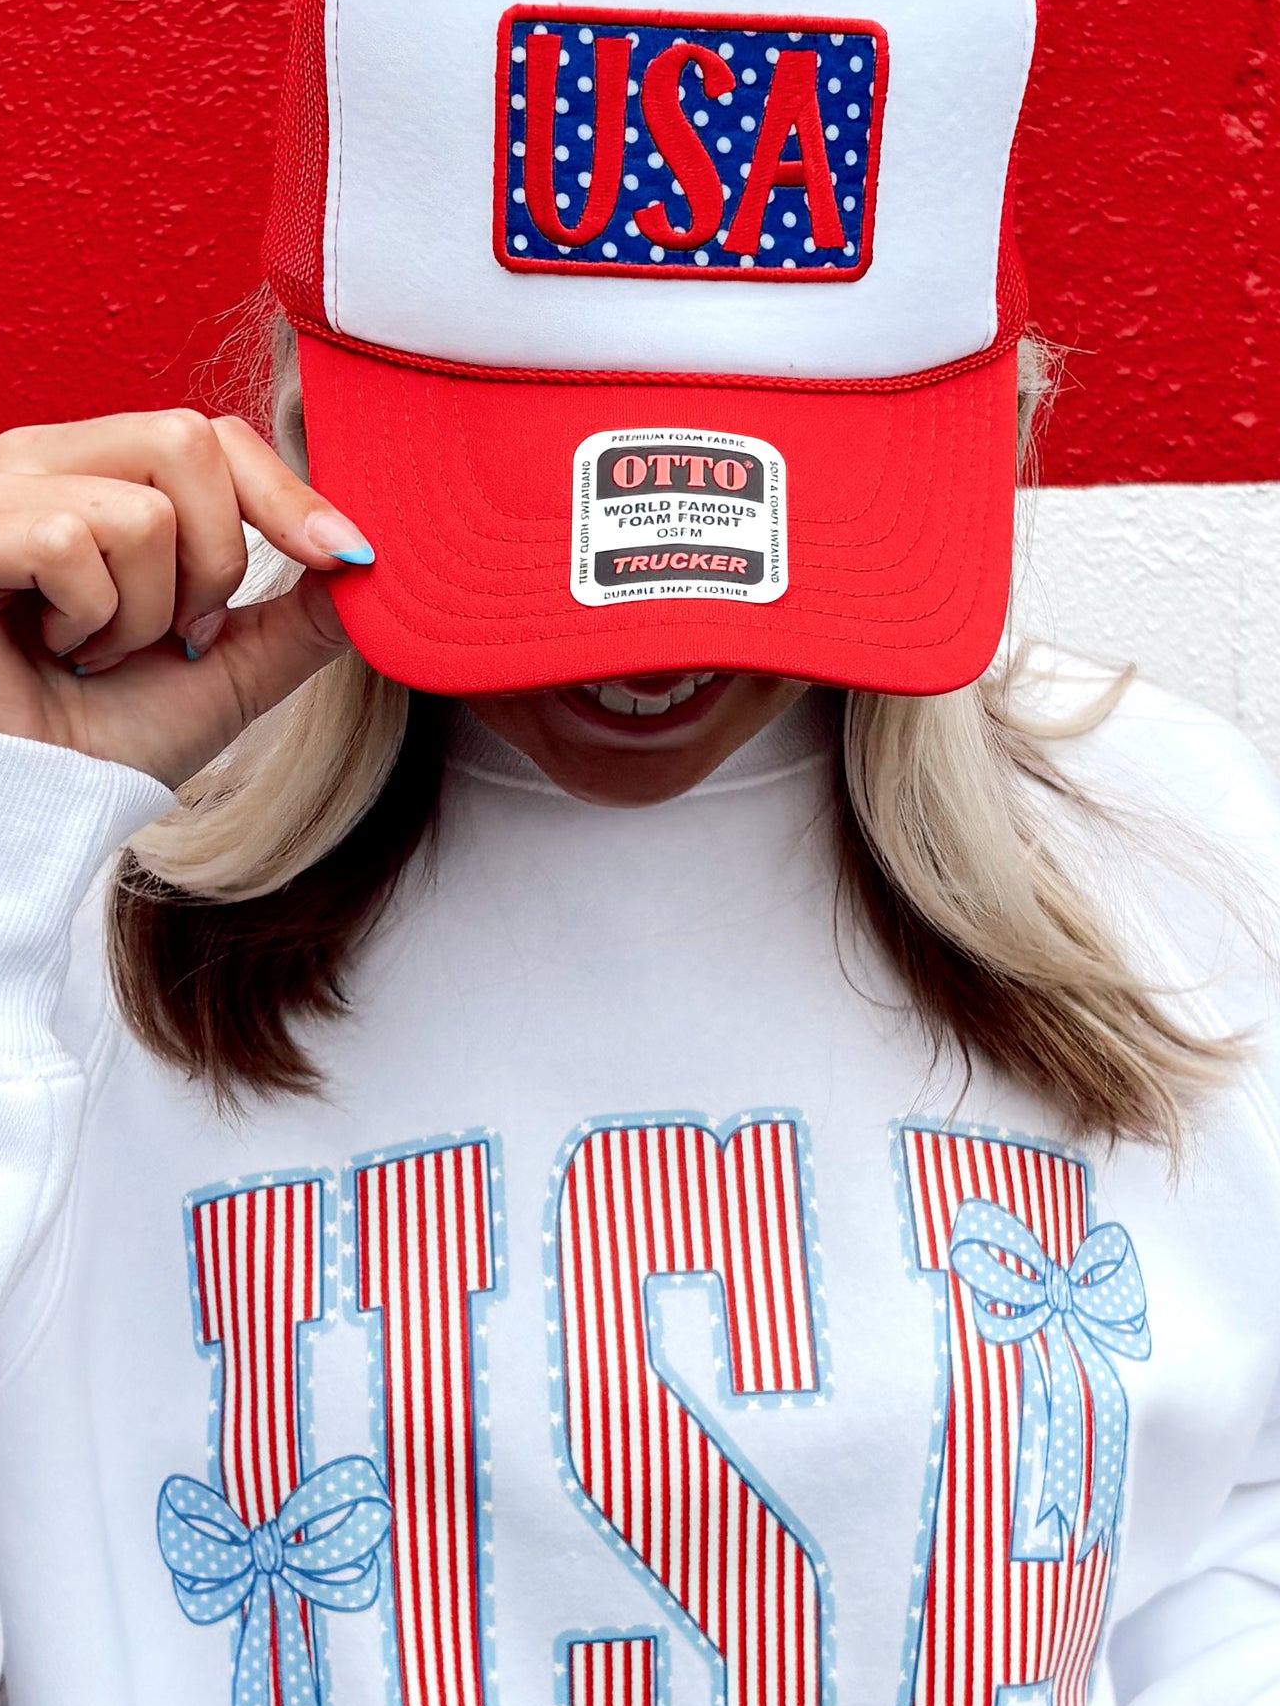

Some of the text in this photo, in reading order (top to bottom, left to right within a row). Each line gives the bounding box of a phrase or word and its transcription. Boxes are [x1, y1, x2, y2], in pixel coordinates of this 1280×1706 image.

[523, 32, 848, 257] USA
[611, 433, 747, 449] PREMIUM FOAM FABRIC
[611, 454, 749, 492] OTTO
[580, 460, 591, 521] SWEATBAND
[604, 500, 757, 518] WORLD FAMOUS
[618, 513, 743, 529] FOAM FRONT
[580, 523, 590, 554] CLOTH
[656, 527, 703, 539] OSFM
[613, 552, 748, 575] TRUCKER
[603, 585, 749, 600] DURABLE SNAP CLOSURE
